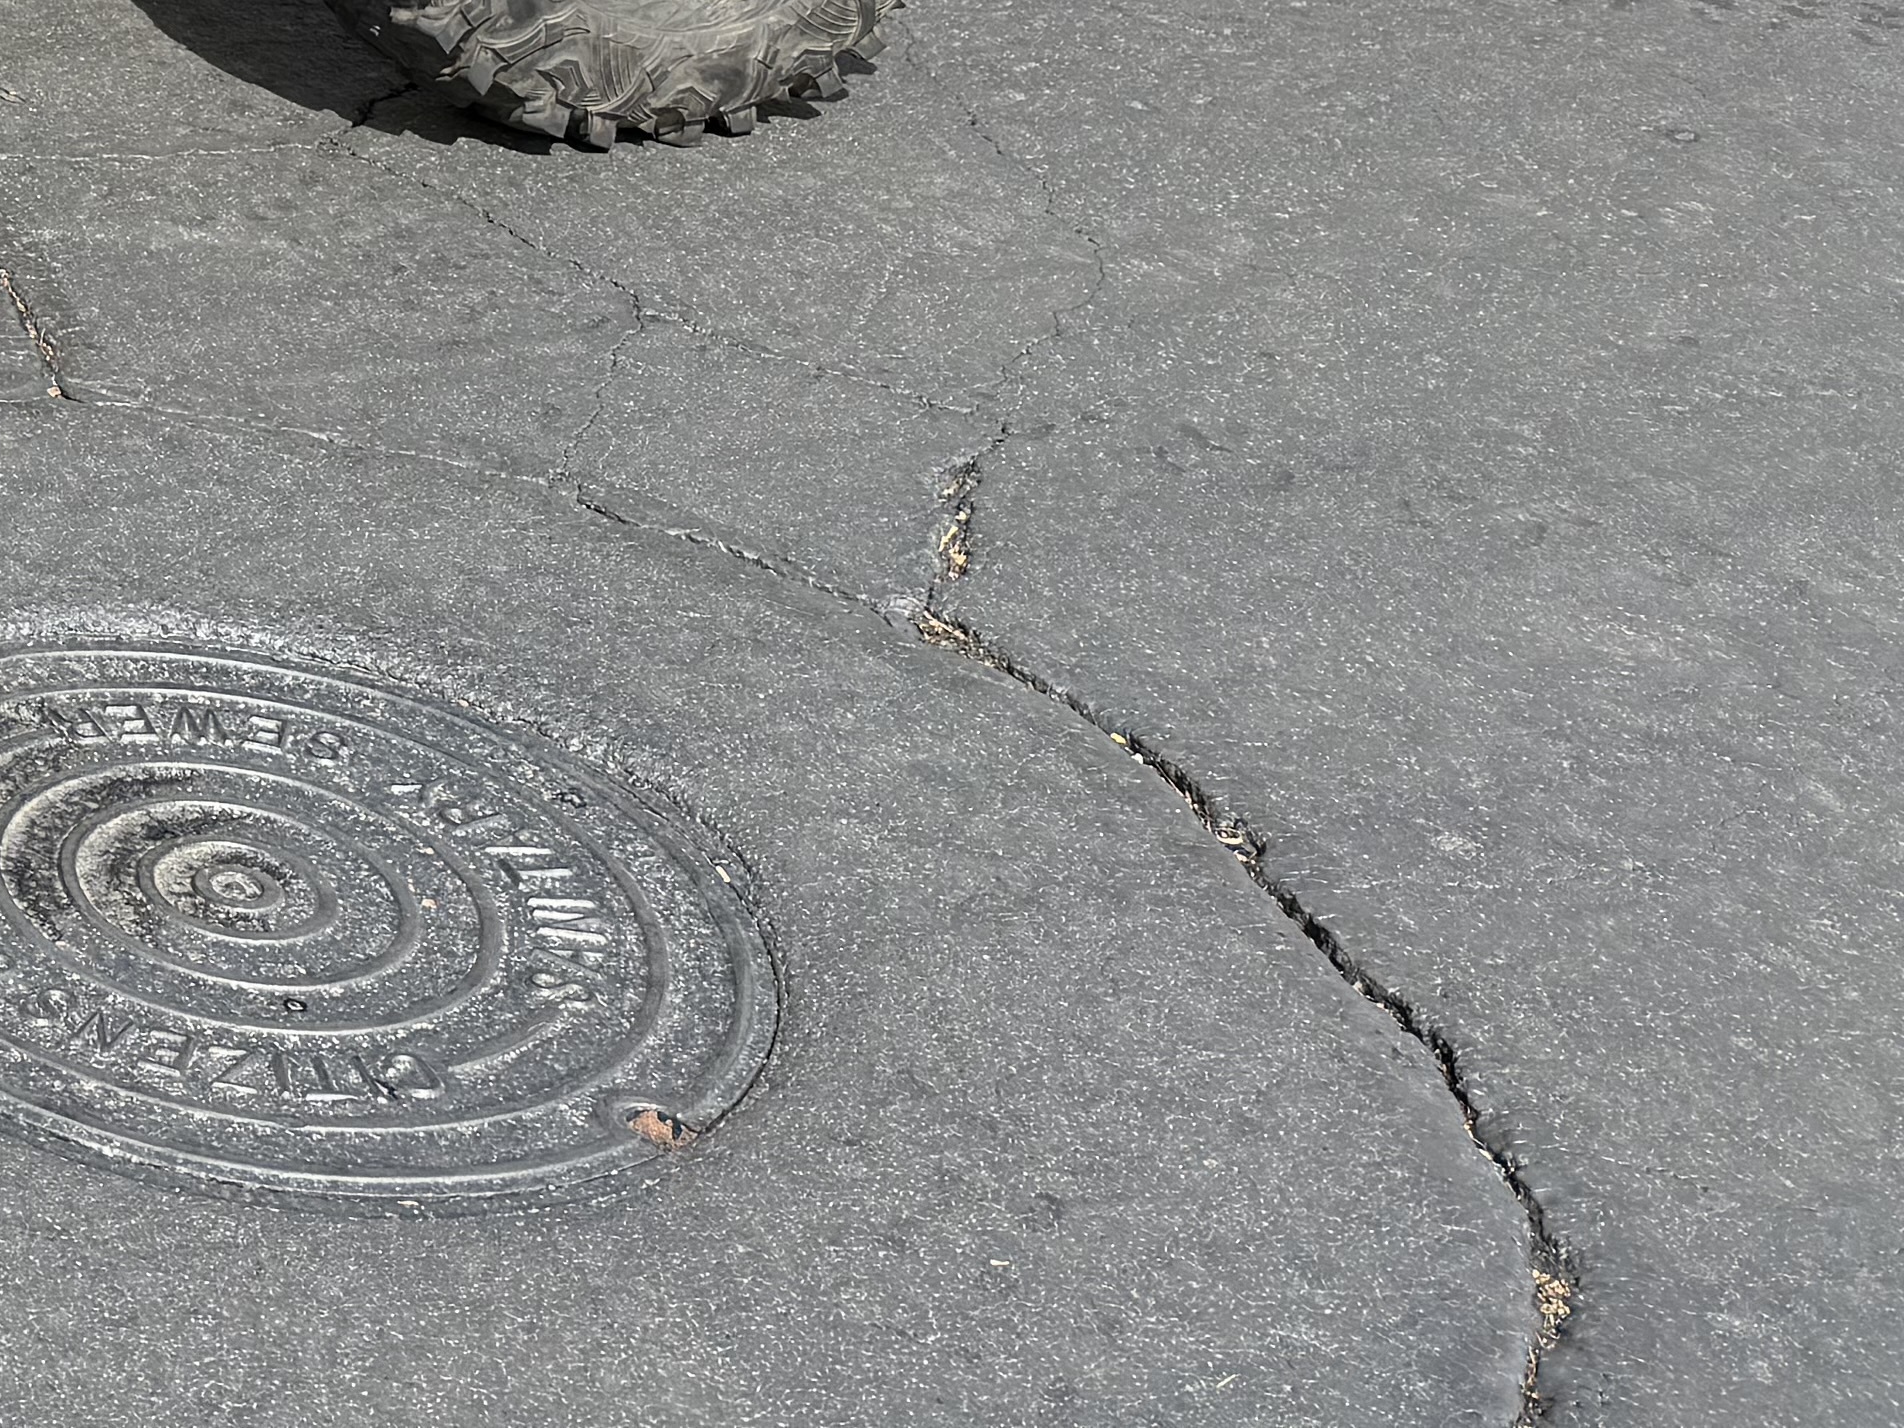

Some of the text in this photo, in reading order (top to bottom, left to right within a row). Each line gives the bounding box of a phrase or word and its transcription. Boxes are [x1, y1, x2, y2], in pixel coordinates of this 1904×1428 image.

[38, 697, 354, 766] SEWER
[388, 772, 617, 1014] SANITARY
[20, 984, 448, 1106] CITIZENS
